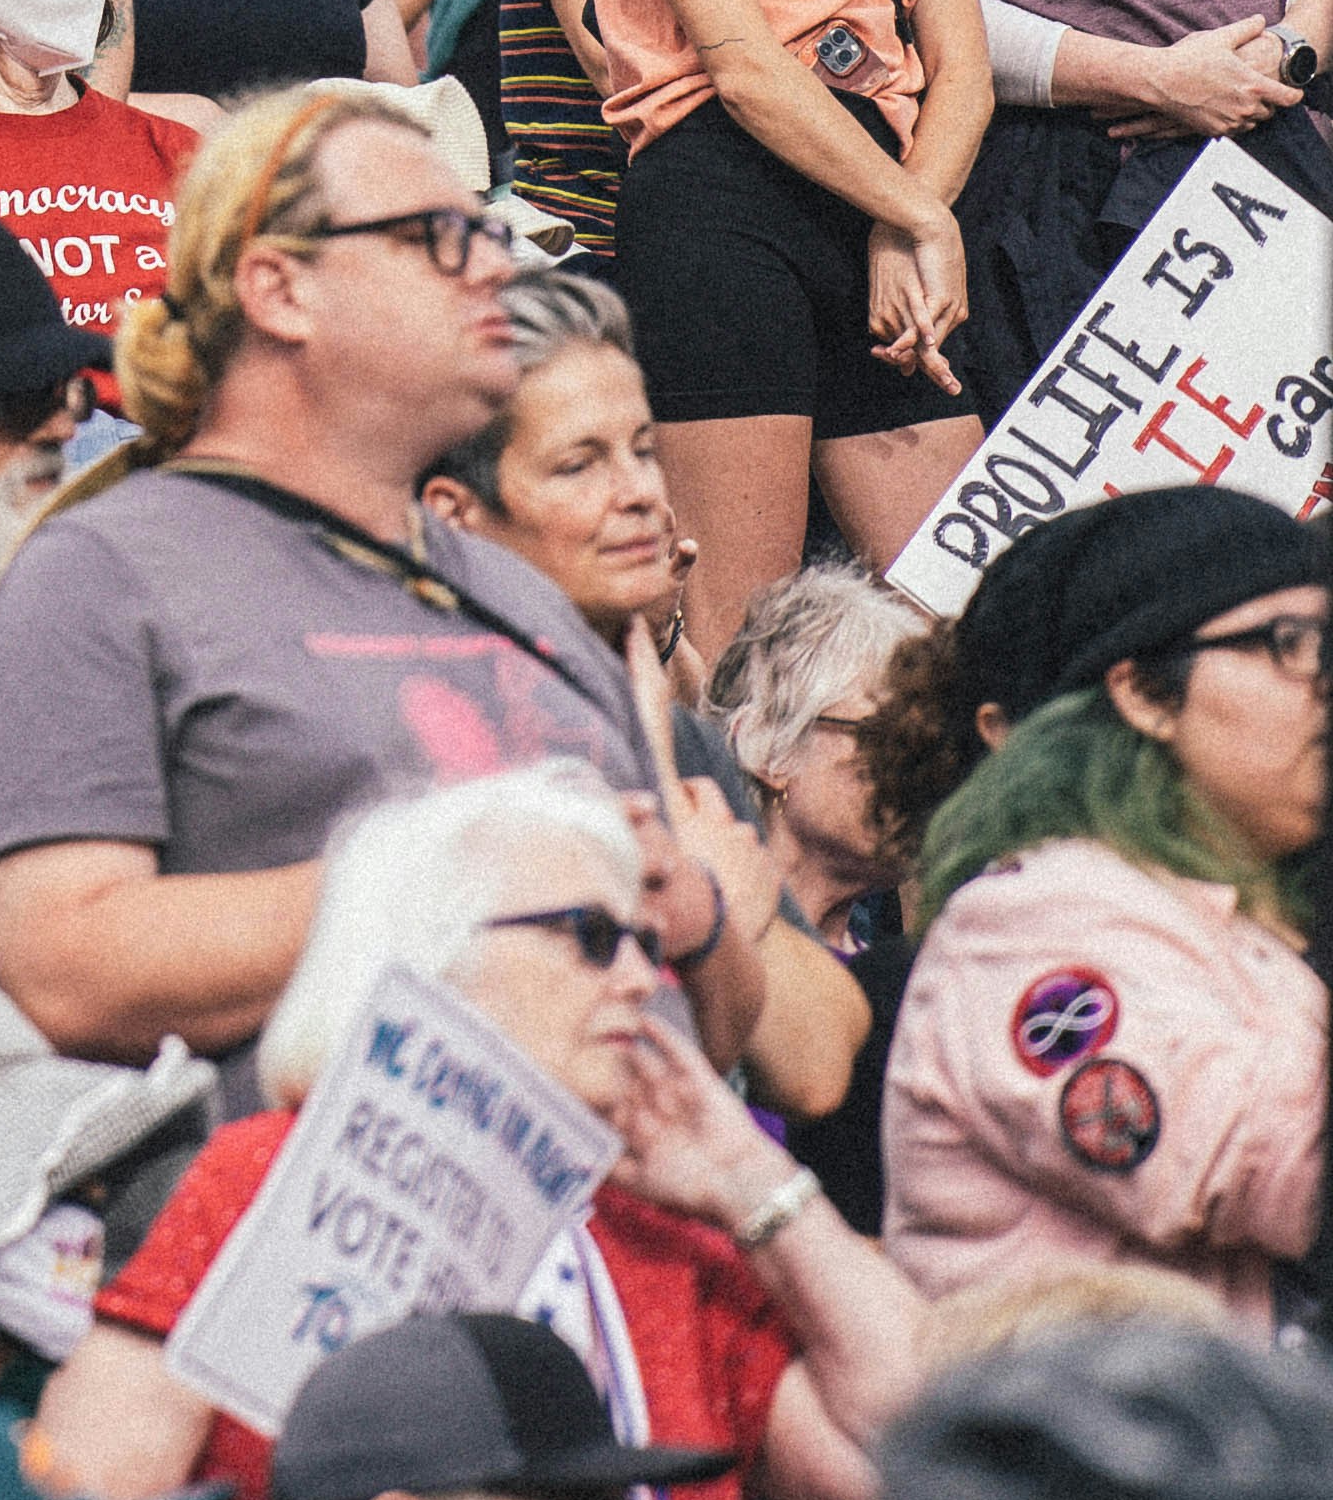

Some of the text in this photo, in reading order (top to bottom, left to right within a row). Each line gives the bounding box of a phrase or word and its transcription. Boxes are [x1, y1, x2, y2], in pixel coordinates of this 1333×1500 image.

[18, 233, 121, 279] NOT
[932, 180, 1288, 570] PROLIFE IS A
[1102, 352, 1268, 500] IE
[306, 1169, 425, 1292] VOTE
